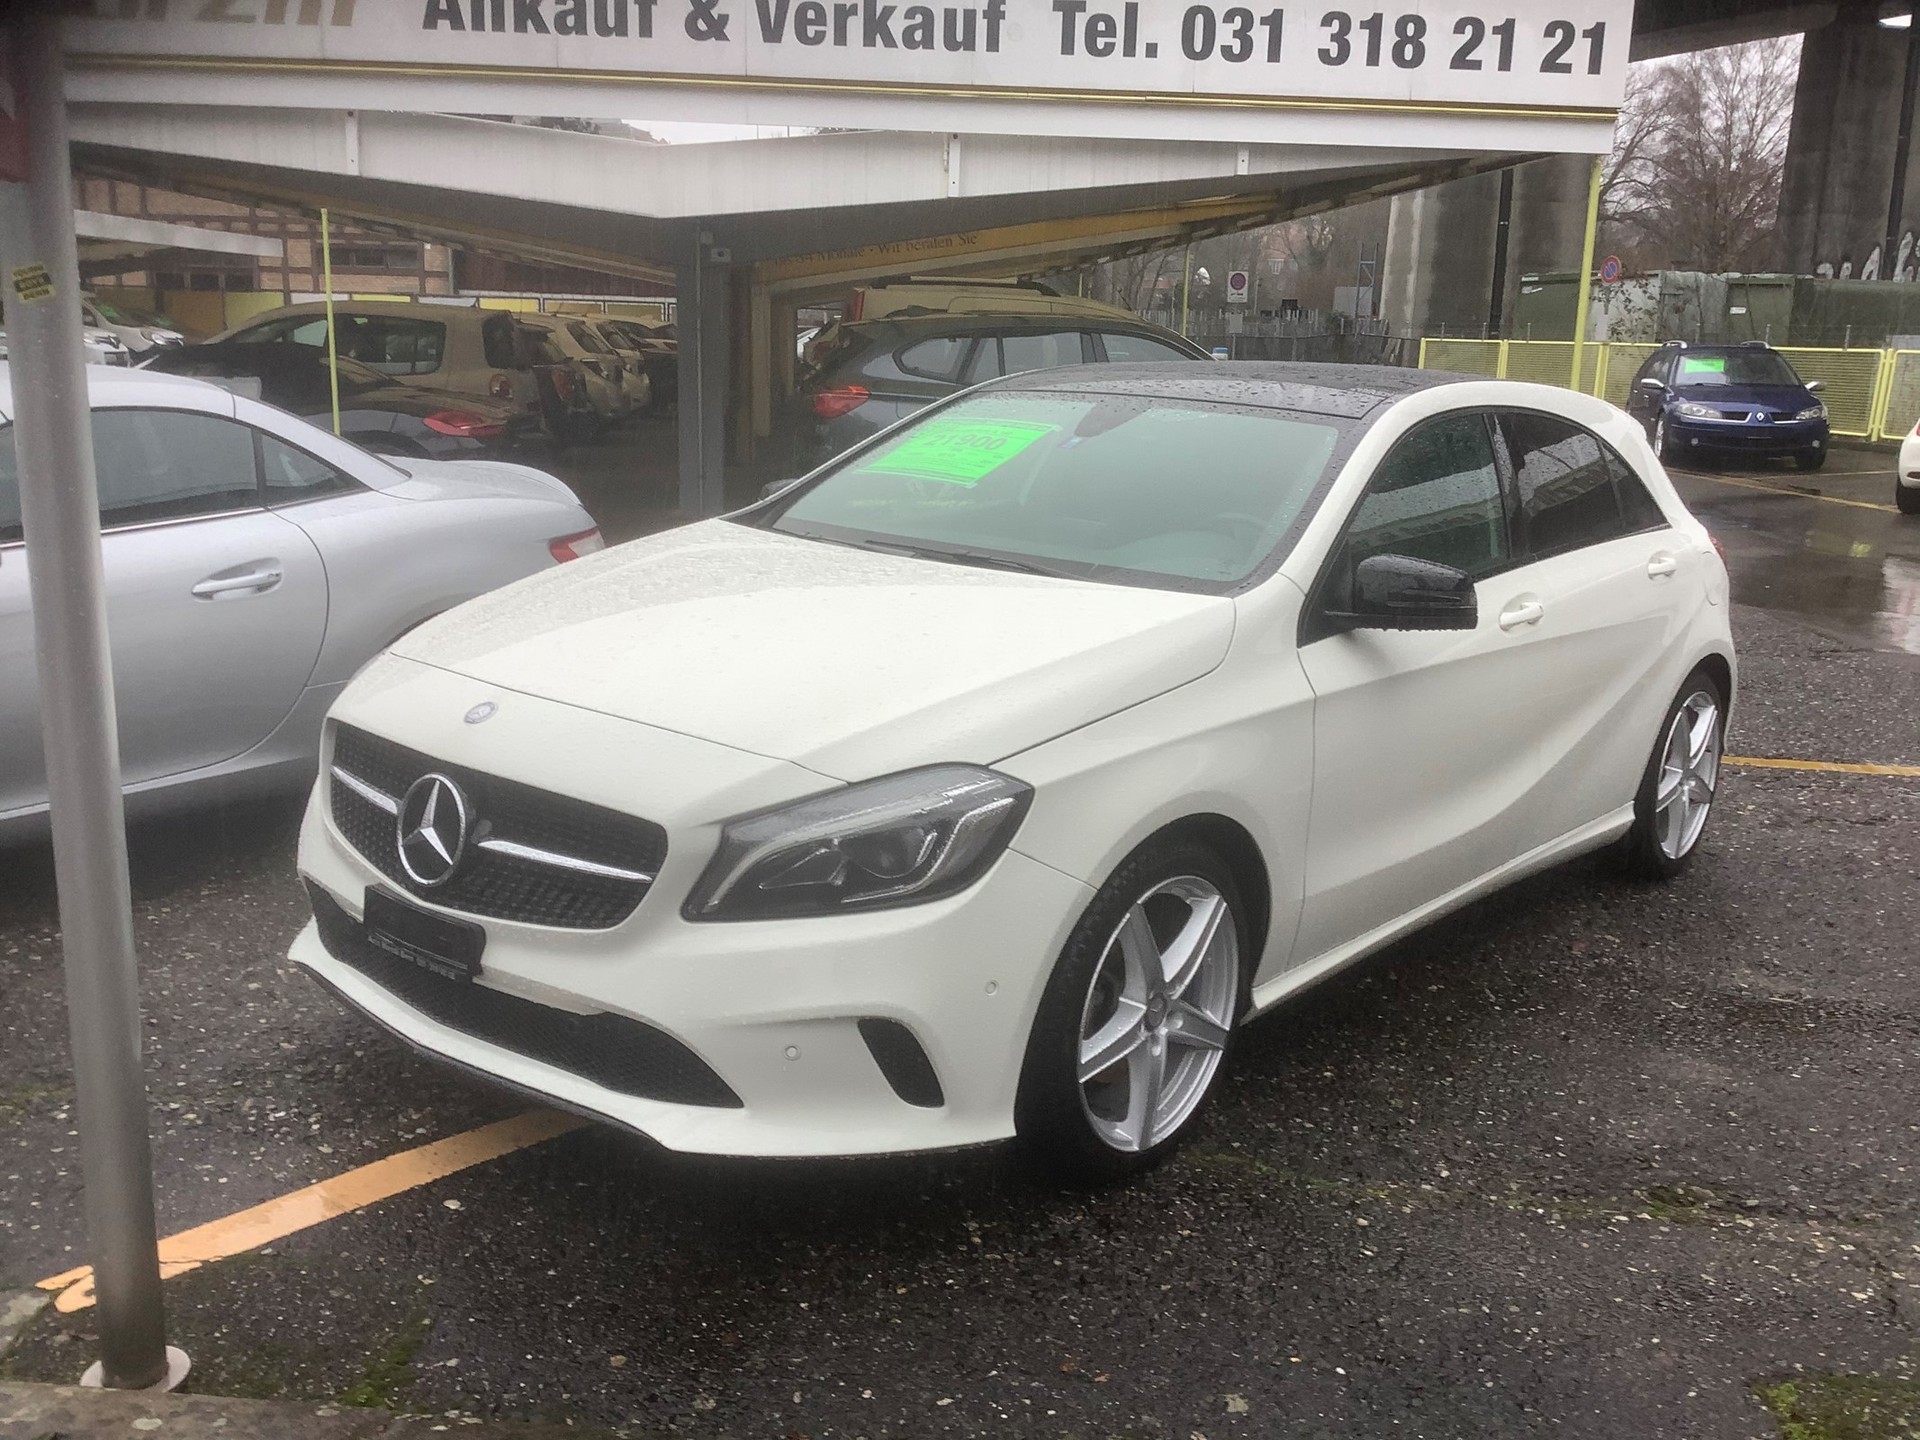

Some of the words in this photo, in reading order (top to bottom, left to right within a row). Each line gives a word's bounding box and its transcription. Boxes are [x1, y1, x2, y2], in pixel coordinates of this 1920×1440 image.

[422, 0, 657, 38] Ankauf
[684, 0, 731, 42] &
[757, 0, 1006, 52] Verkauf
[1052, 0, 1158, 59] Tel.
[1181, 5, 1285, 64] 031
[1317, 11, 1427, 69] 318
[1449, 16, 1517, 72] 21
[1540, 20, 1607, 75] 21
[956, 231, 977, 246] Sie
